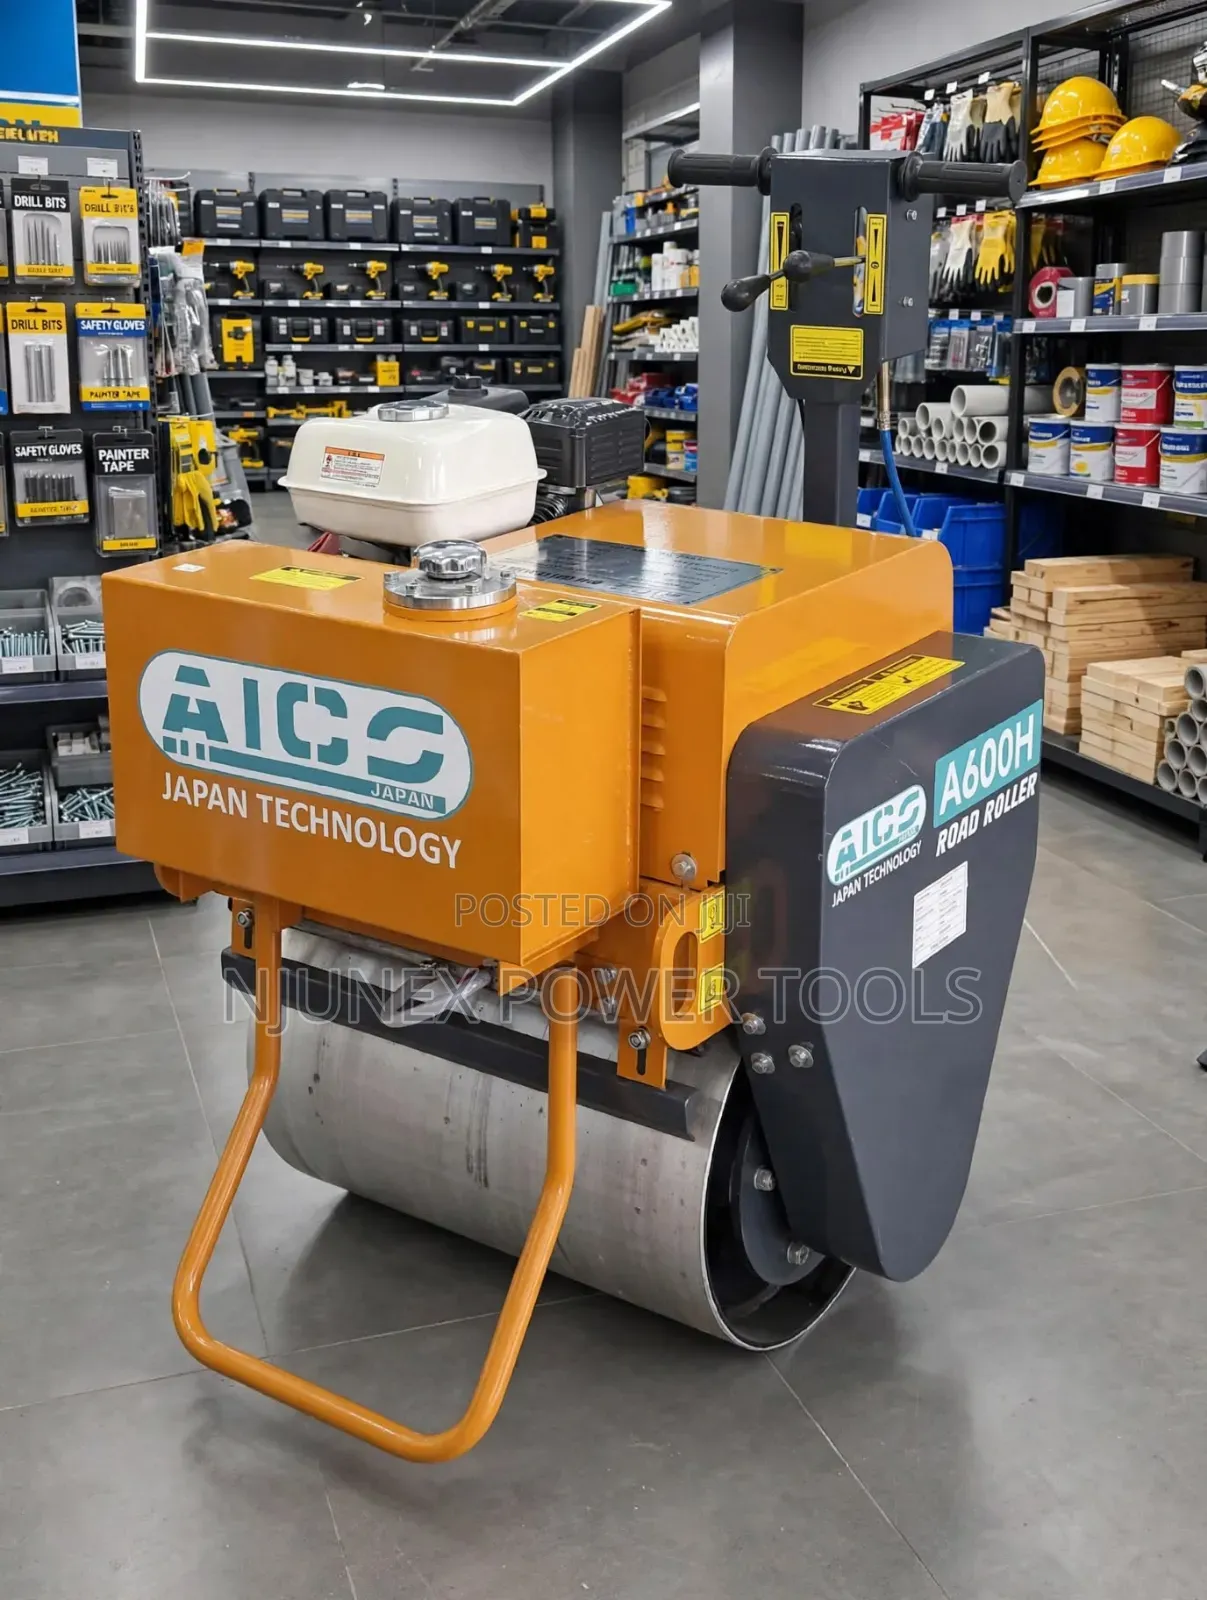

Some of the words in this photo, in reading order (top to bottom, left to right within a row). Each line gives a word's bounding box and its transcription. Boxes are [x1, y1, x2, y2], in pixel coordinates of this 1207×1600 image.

[14, 195, 43, 207] DRILL
[45, 196, 66, 209] BITS
[11, 319, 39, 330] DRILL
[42, 320, 63, 331] BITS
[80, 320, 112, 330] SAFETY
[113, 320, 145, 331] GLOVES
[14, 445, 47, 457] SAFETY
[48, 443, 83, 455] GLOVES
[98, 448, 150, 460] PAINTER
[102, 461, 135, 472] TAPE
[162, 664, 444, 784] AICS
[939, 713, 1034, 816] A600H
[369, 782, 435, 810] JAPAN
[162, 772, 248, 819] JAPAN
[255, 793, 462, 869] TECHNOLOGY
[935, 809, 980, 857] ROAD
[983, 772, 1038, 827] ROLLER
[834, 790, 920, 874] AICS
[832, 877, 862, 908] JAPAN
[863, 840, 922, 888] TECHNOLOGY
